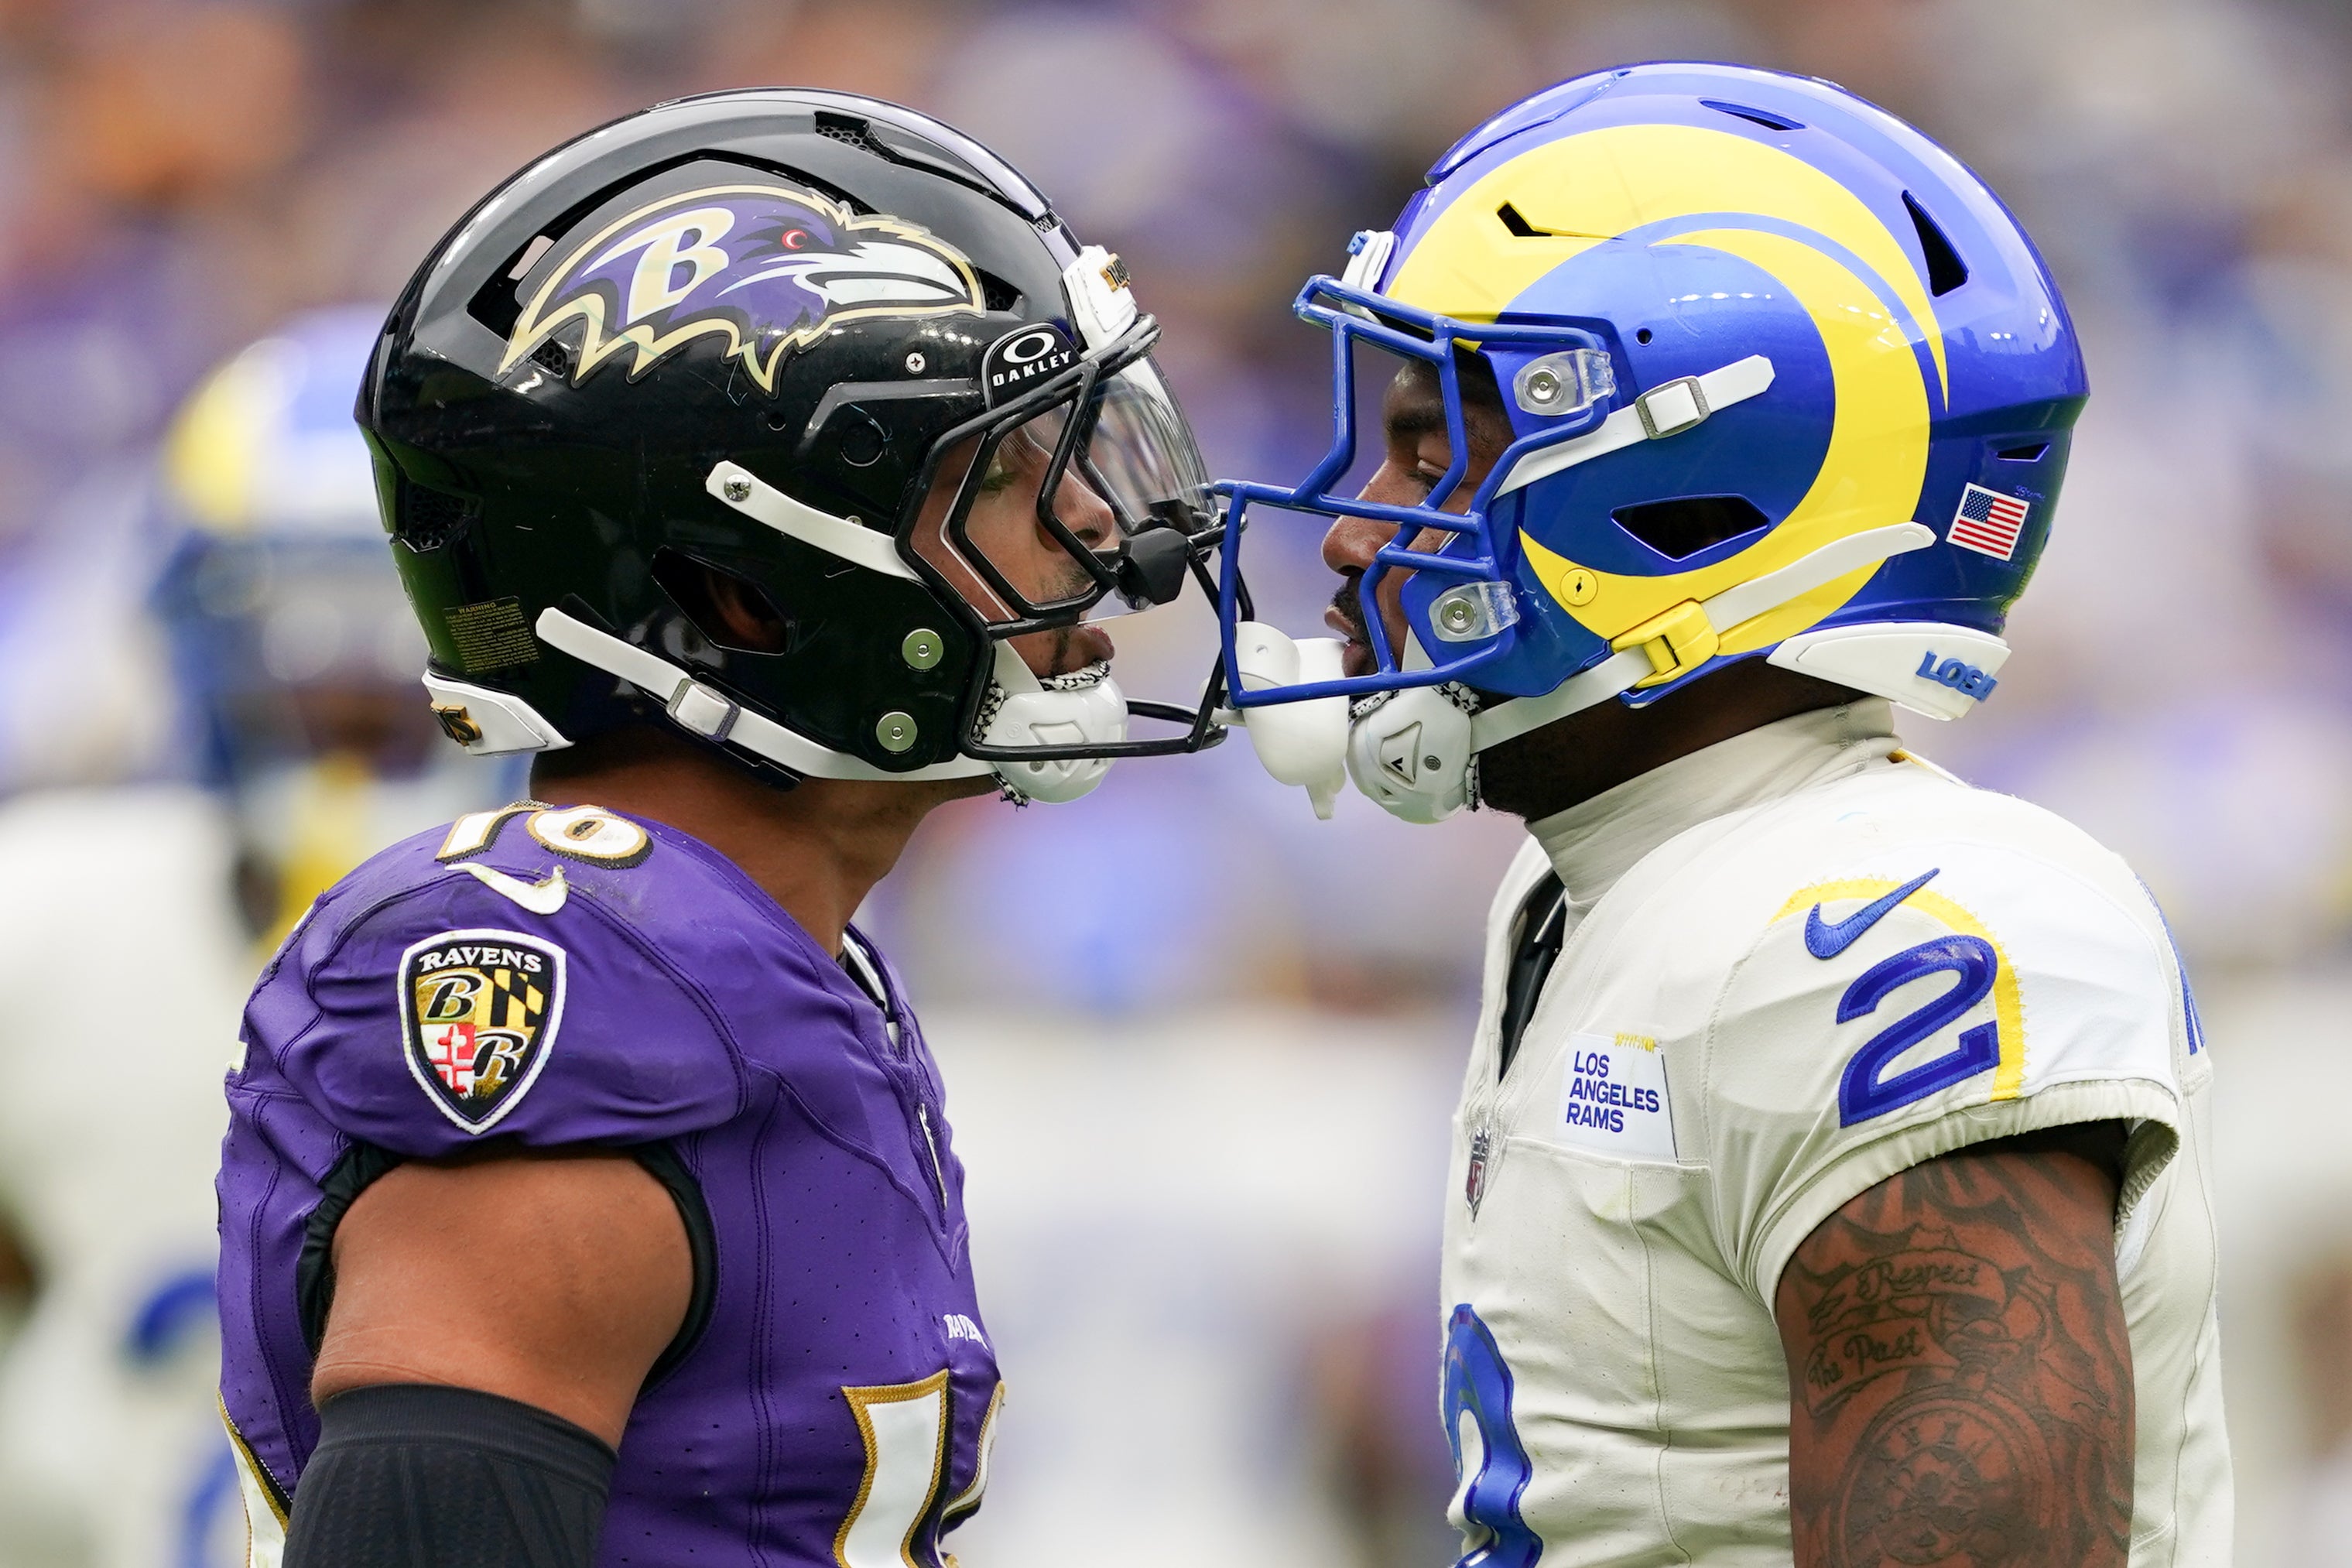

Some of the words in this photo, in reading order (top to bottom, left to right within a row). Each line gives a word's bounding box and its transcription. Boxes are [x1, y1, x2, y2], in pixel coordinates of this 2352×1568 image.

[580, 207, 735, 325] B
[992, 351, 1071, 387] OAKLEY
[458, 602, 497, 615] WARNING
[419, 947, 543, 973] RAVENS
[418, 971, 485, 1022] B
[1836, 935, 2001, 1128] 2
[1573, 1050, 1610, 1078] LOS
[1570, 1077, 1660, 1113] ANGELES
[1566, 1102, 1624, 1133] RAMS
[1844, 1326, 1926, 1375] Past
